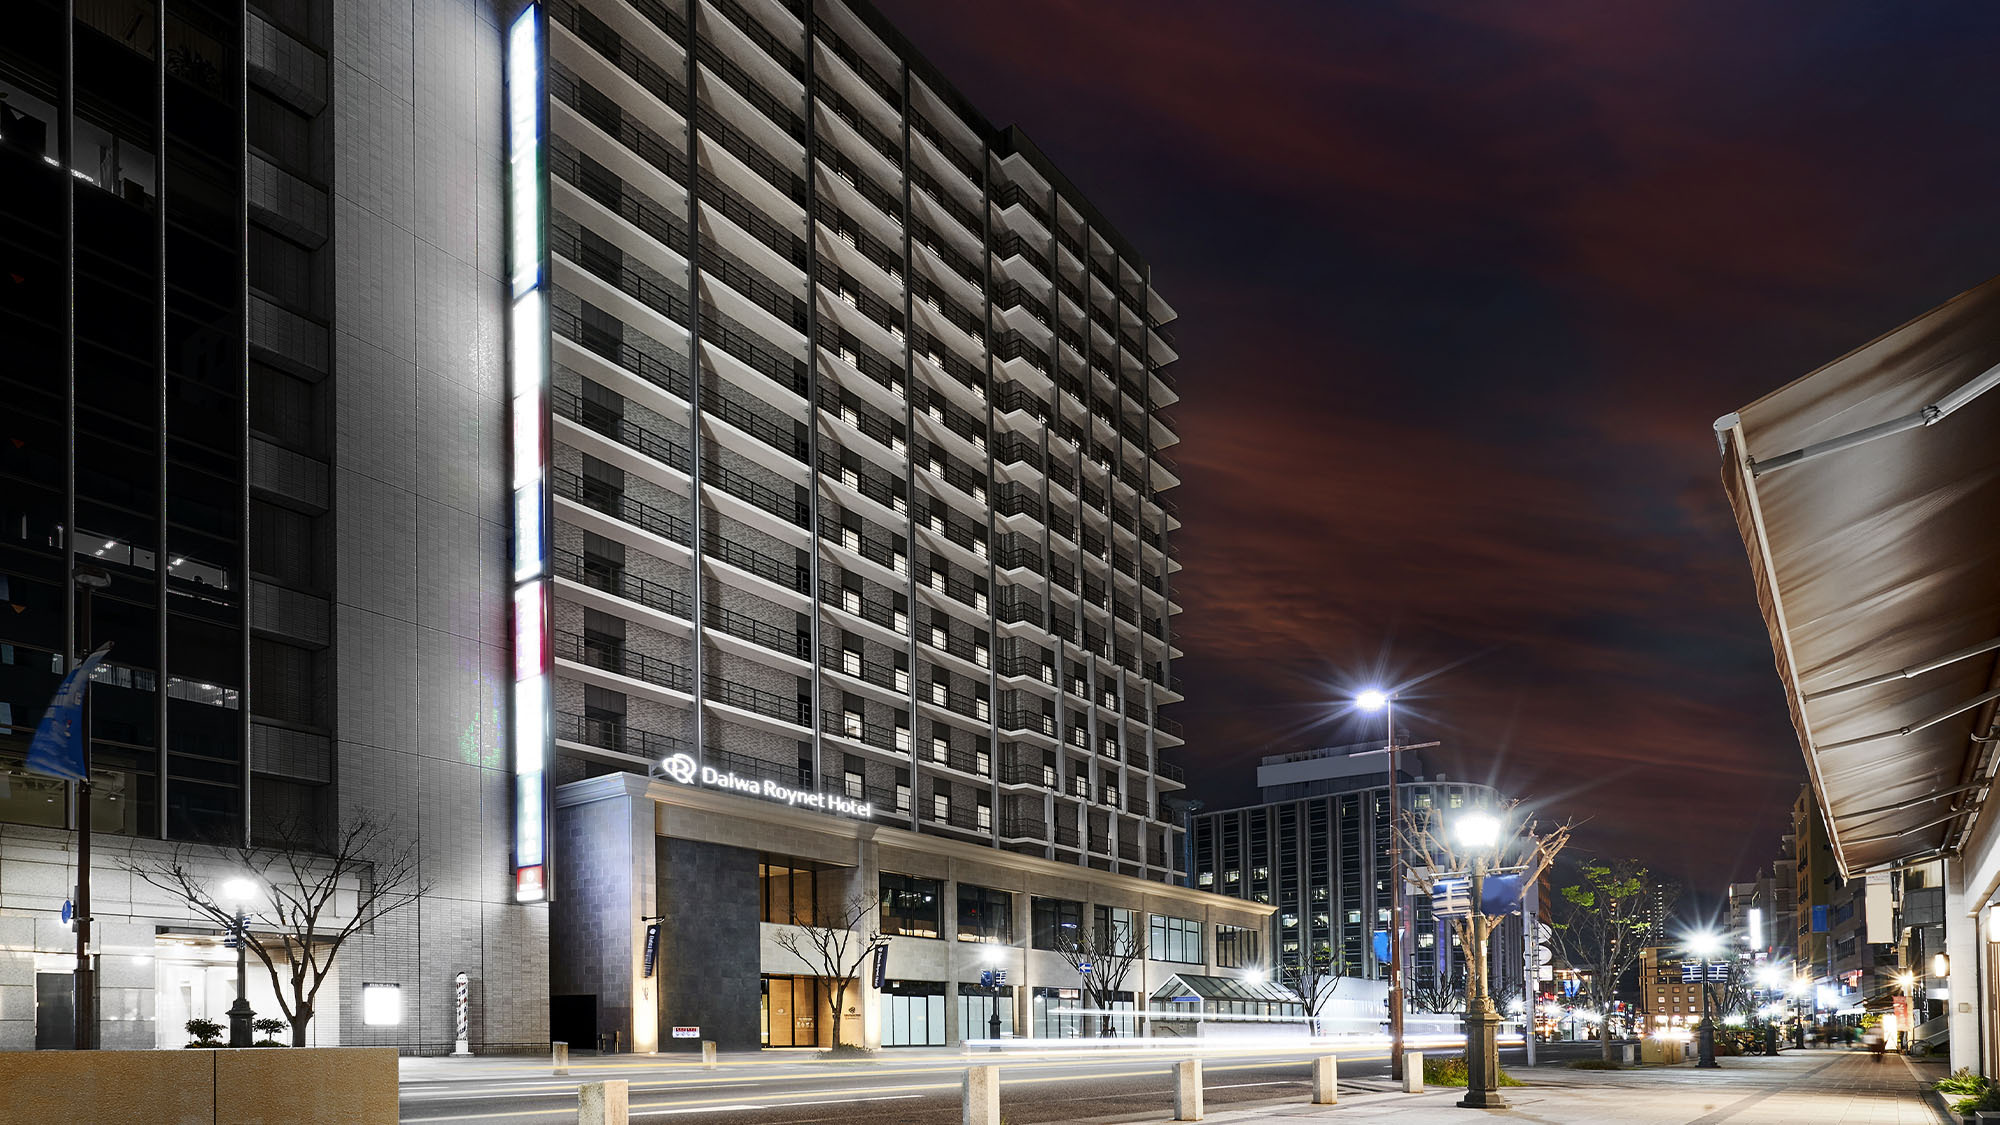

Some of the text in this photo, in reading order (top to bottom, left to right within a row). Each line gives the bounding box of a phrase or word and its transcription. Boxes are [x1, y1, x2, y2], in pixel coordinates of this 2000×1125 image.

[702, 767, 872, 817] Daiwa Roynet Hotel
